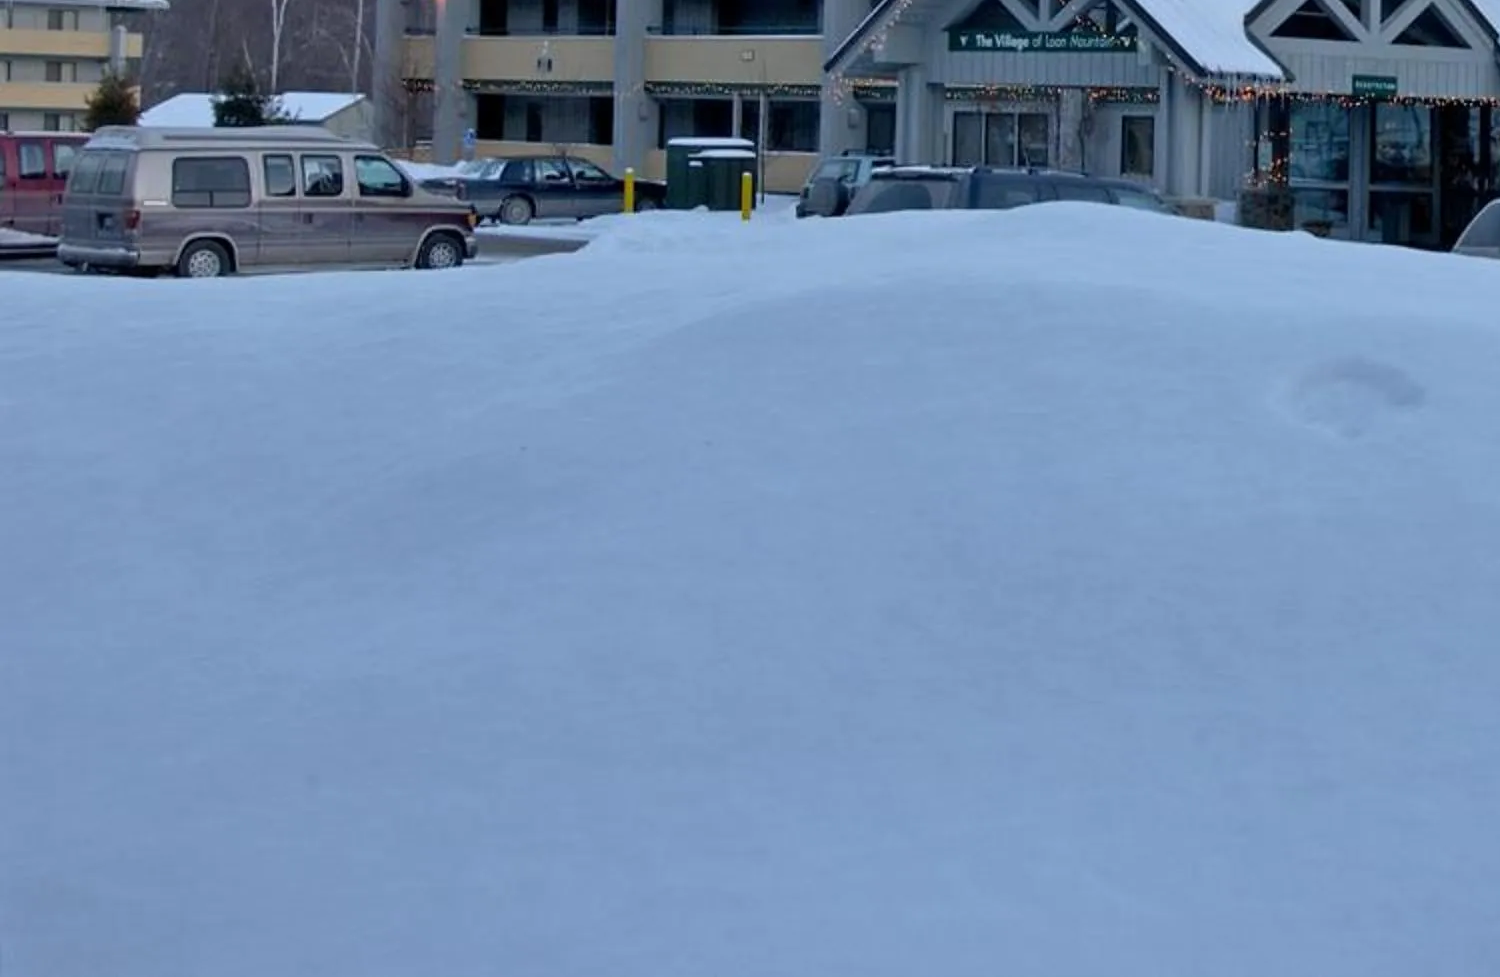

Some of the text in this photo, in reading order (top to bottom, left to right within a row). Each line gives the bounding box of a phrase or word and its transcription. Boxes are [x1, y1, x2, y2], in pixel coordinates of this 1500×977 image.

[975, 34, 993, 48] The
[994, 34, 1029, 51] Village
[1032, 34, 1042, 48] of
[1045, 34, 1067, 48] Loon
